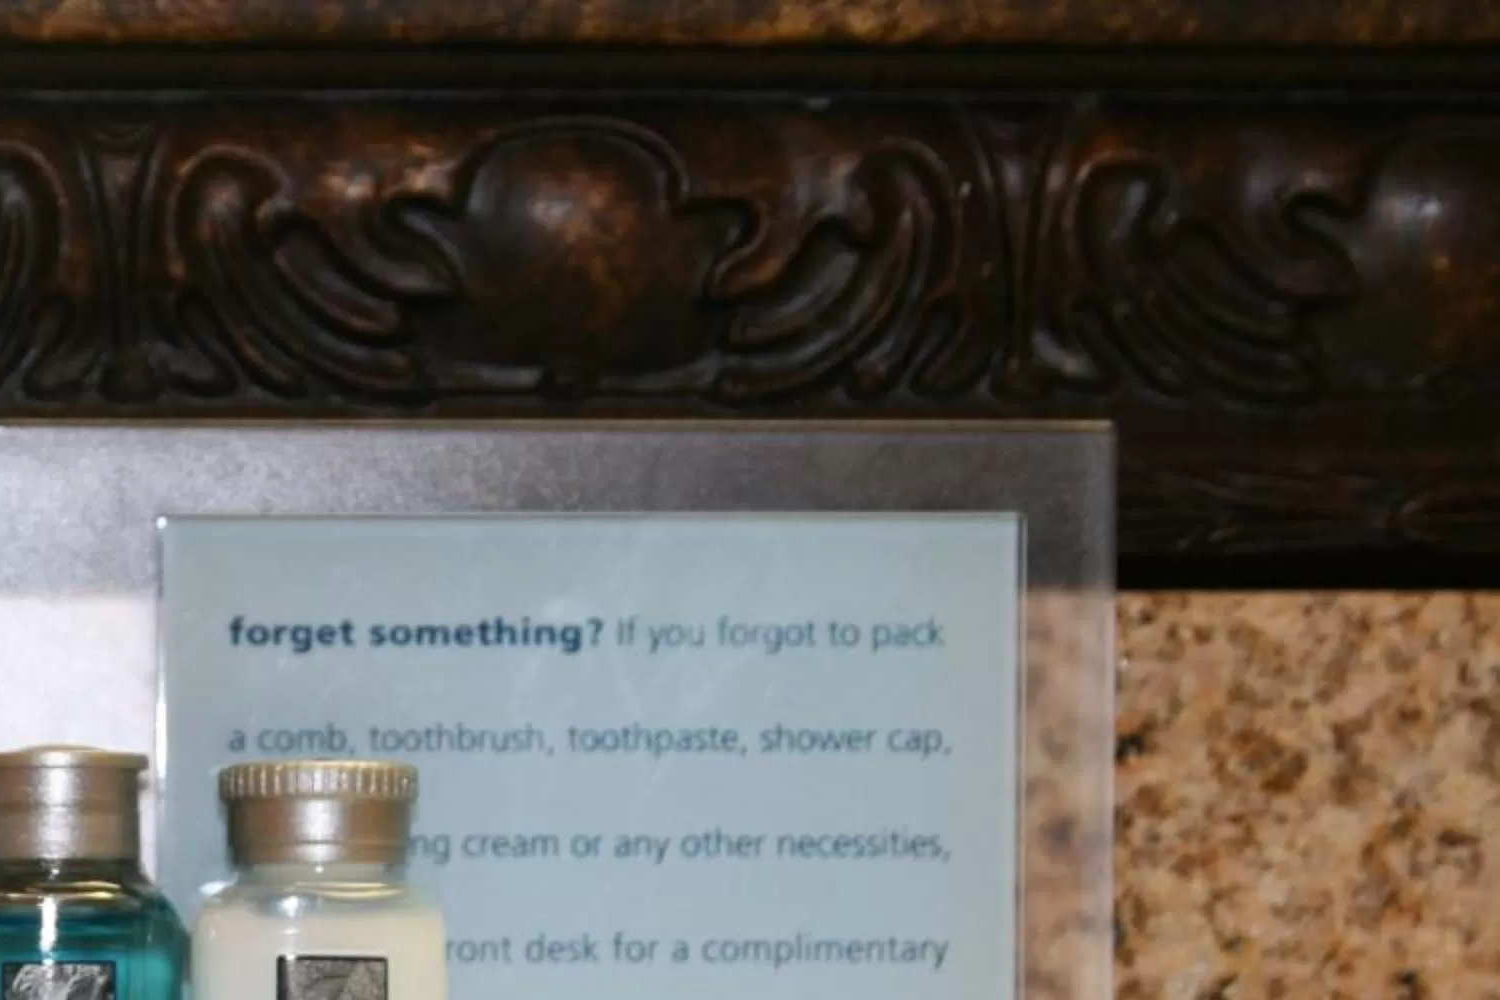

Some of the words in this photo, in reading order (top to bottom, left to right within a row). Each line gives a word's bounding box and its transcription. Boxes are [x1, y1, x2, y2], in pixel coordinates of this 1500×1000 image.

[229, 616, 354, 654] forget
[369, 616, 604, 654] something?
[617, 617, 639, 647] If
[648, 623, 705, 654] you
[717, 616, 816, 654] forgot
[828, 620, 860, 648] to
[872, 617, 945, 653] pack
[228, 729, 246, 753] a
[256, 723, 357, 758] comb,
[368, 722, 555, 757] toothbrush,
[568, 723, 749, 759] toothpaste,
[760, 724, 876, 753] shower
[887, 729, 952, 760] cap,
[460, 834, 560, 859] cream
[570, 834, 603, 859] or
[613, 834, 671, 866] any
[680, 829, 765, 859] other
[777, 829, 952, 864] necessities,
[445, 936, 513, 964] ront
[524, 933, 598, 963] desk
[611, 932, 660, 964] for
[671, 939, 690, 963] a
[701, 931, 950, 972] complimentary
